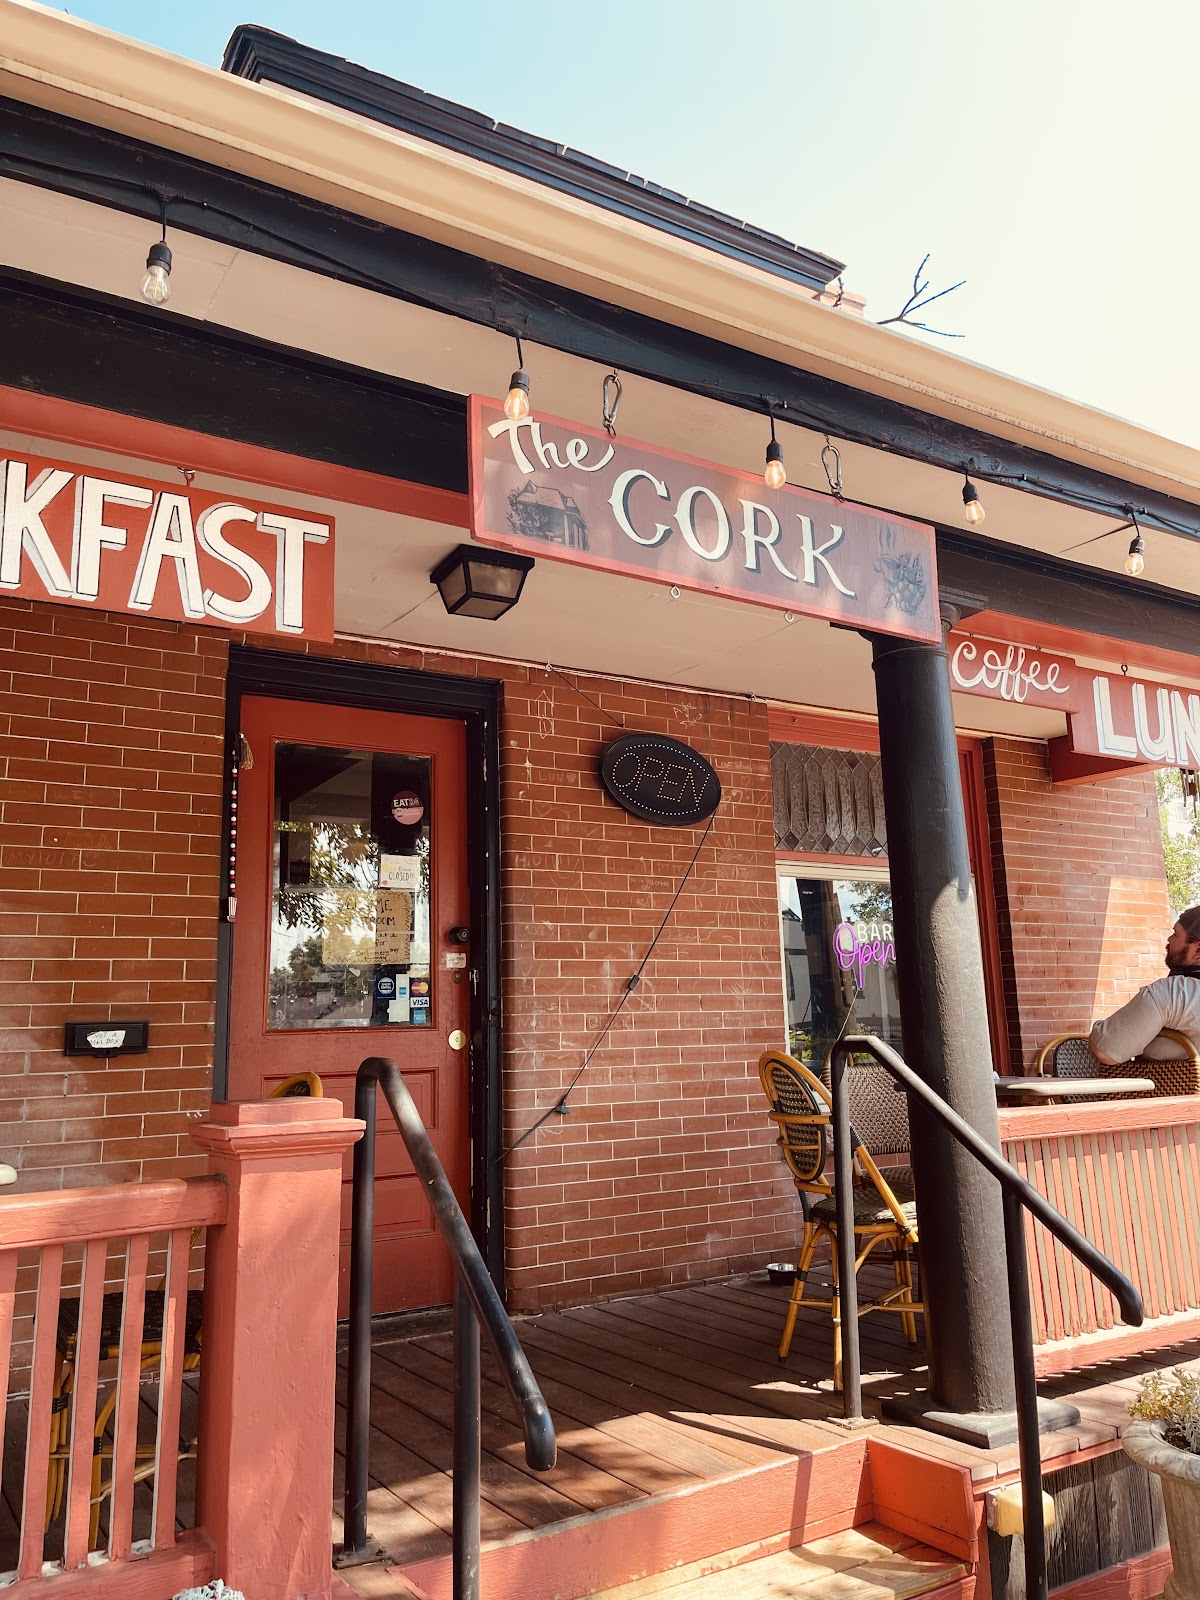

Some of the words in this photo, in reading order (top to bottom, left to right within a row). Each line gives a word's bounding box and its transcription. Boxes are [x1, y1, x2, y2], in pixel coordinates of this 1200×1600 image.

[487, 416, 615, 474] The
[607, 469, 858, 599] CORK
[951, 640, 1070, 703] Coffee
[612, 751, 711, 807] OPEN
[835, 924, 897, 989] Open
[857, 923, 893, 942] BAR
